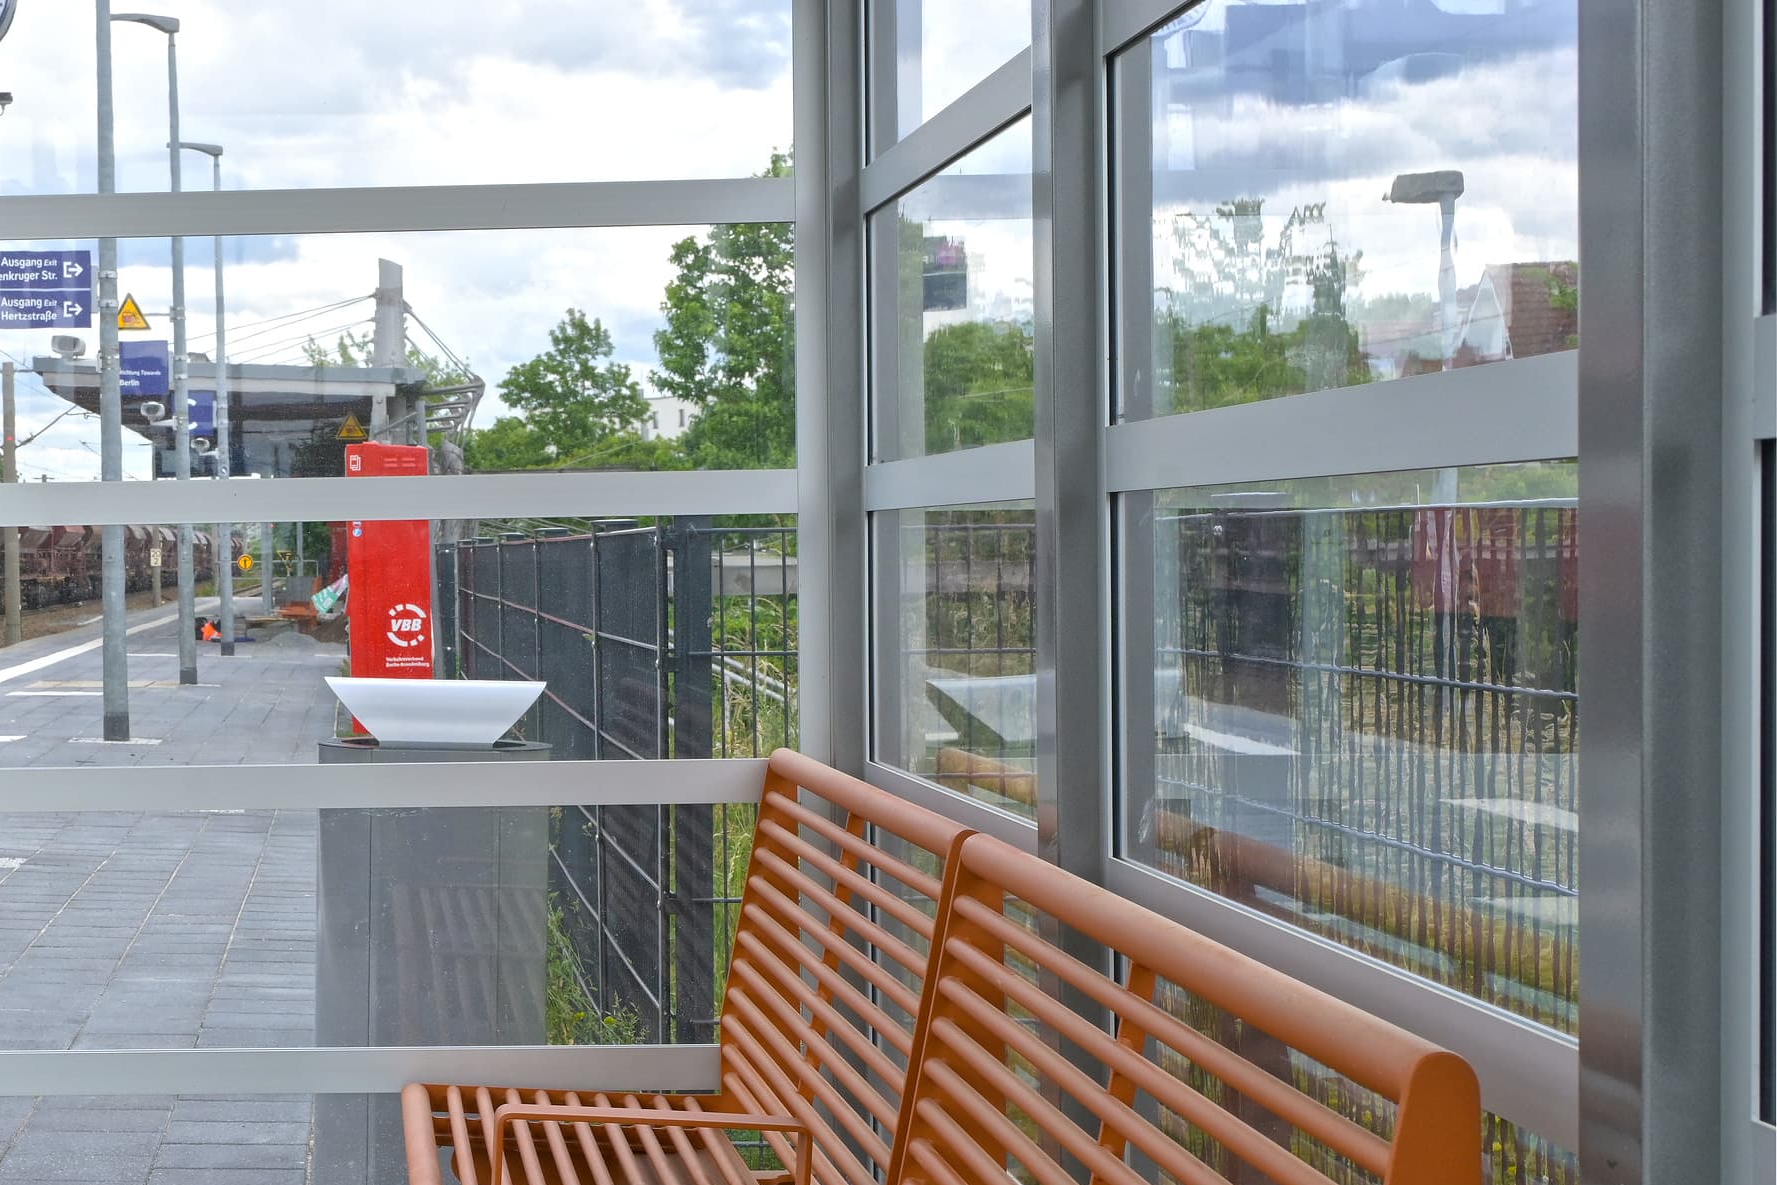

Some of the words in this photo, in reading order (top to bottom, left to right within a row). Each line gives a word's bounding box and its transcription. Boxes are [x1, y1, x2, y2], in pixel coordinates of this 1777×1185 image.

[0, 256, 42, 269] Ausgang
[43, 259, 57, 267] Exit
[41, 270, 58, 280] Str.
[0, 296, 42, 309] Ausgang
[43, 299, 57, 307] Exit
[0, 310, 57, 322] Hertzstraße
[391, 618, 422, 631] VBB
